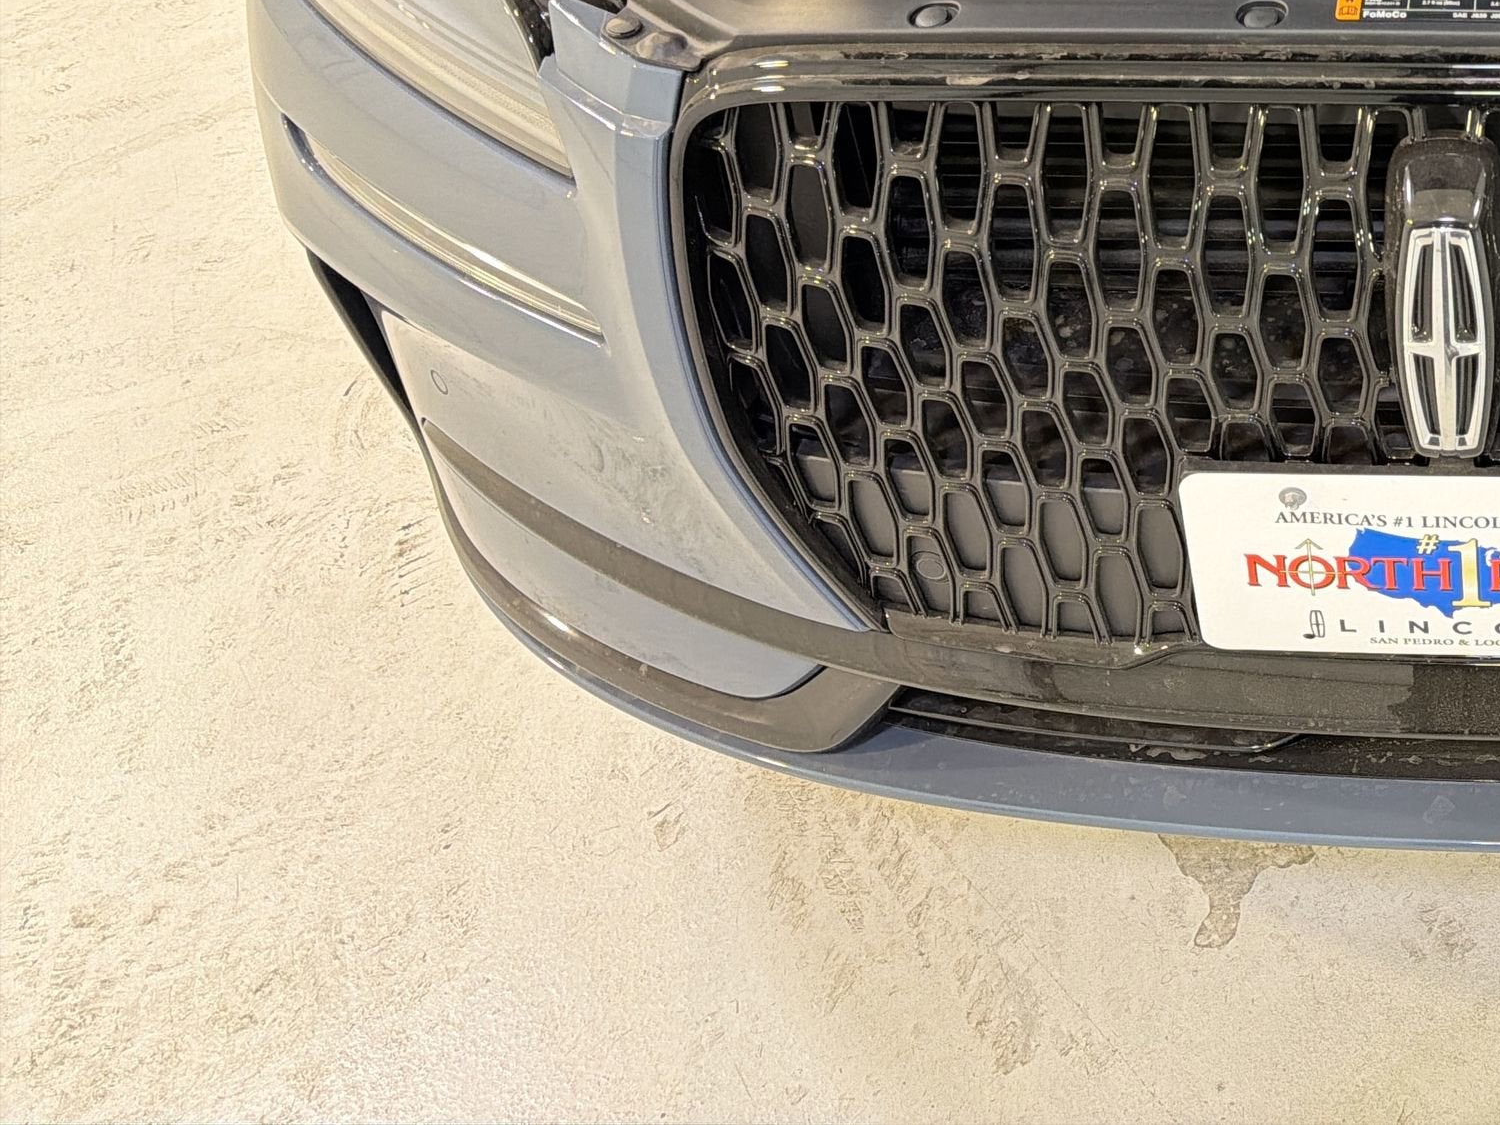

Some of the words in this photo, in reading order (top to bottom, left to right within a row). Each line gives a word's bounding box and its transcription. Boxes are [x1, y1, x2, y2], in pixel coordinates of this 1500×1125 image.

[1274, 511, 1388, 526] AMERICA'S
[1393, 516, 1414, 528] #1
[1244, 553, 1454, 592] NORTH
[1370, 637, 1399, 645] SAN
